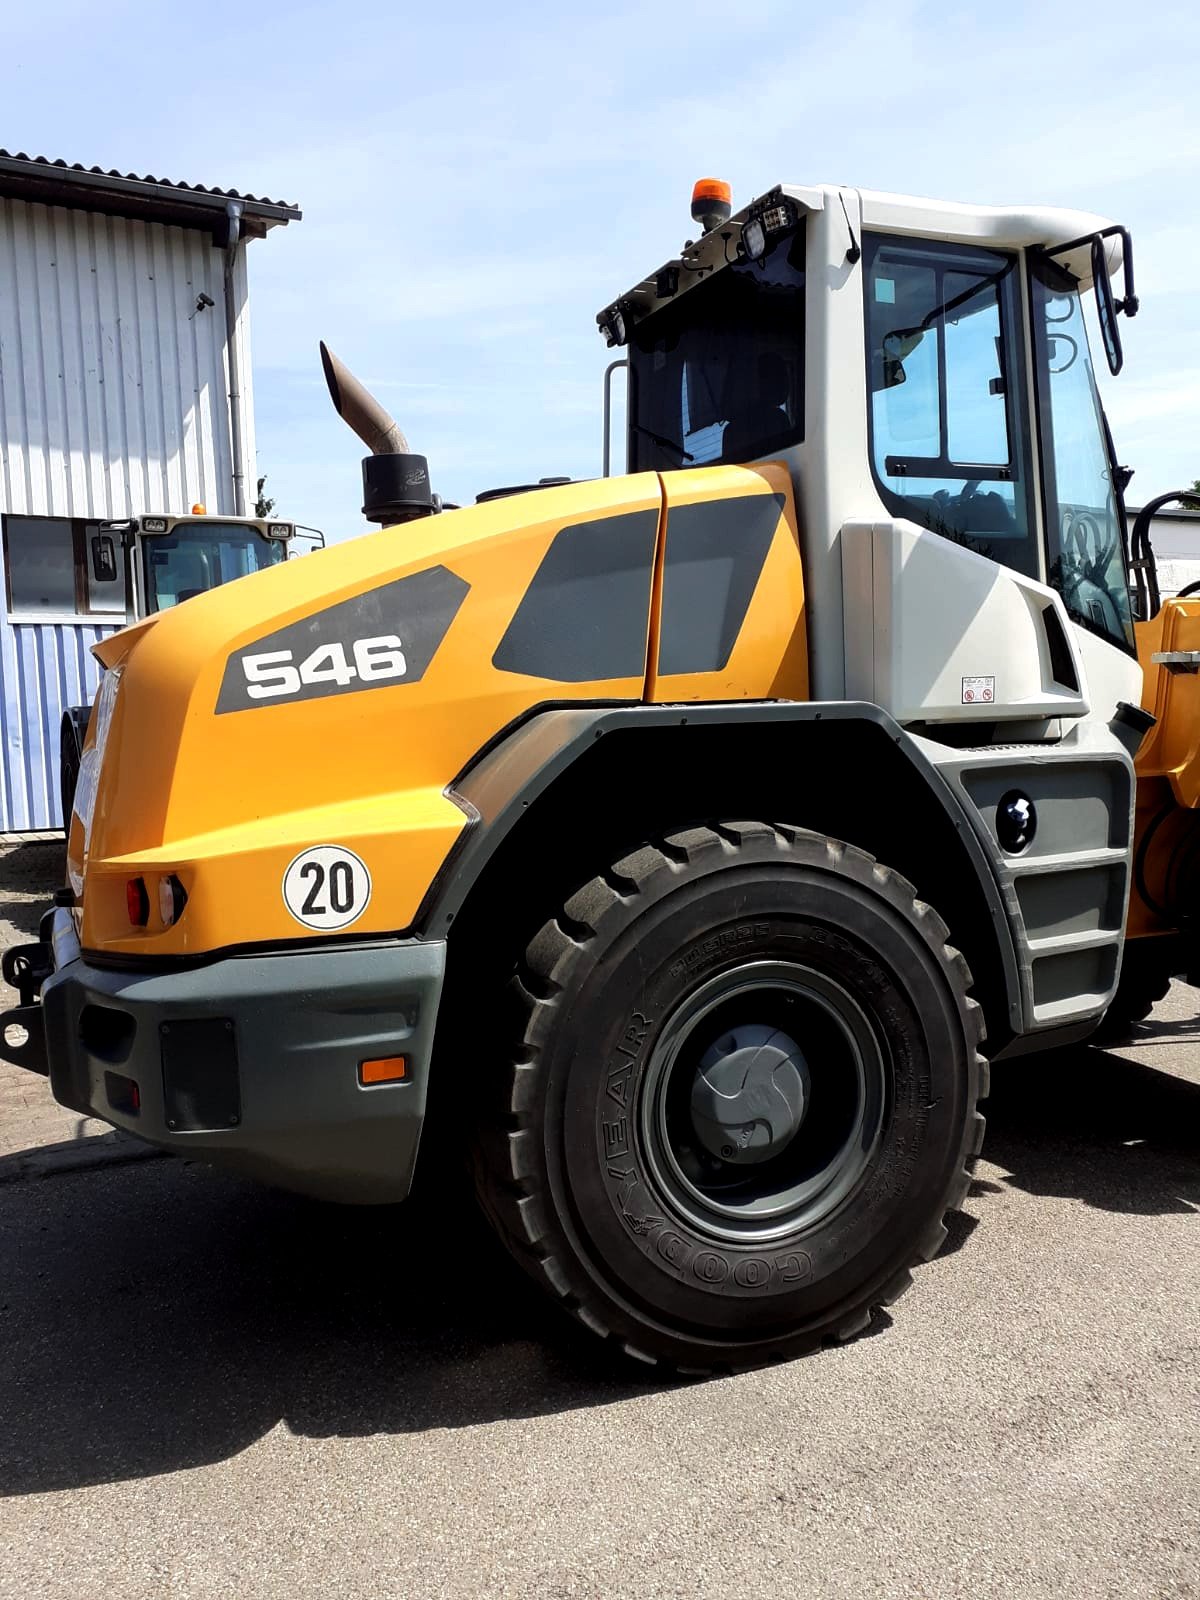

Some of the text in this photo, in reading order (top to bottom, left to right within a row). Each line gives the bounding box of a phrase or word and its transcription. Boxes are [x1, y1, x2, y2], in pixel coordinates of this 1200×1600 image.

[241, 634, 407, 700] 546
[299, 861, 354, 915] 20
[601, 1007, 813, 1289] GOODYEAR
